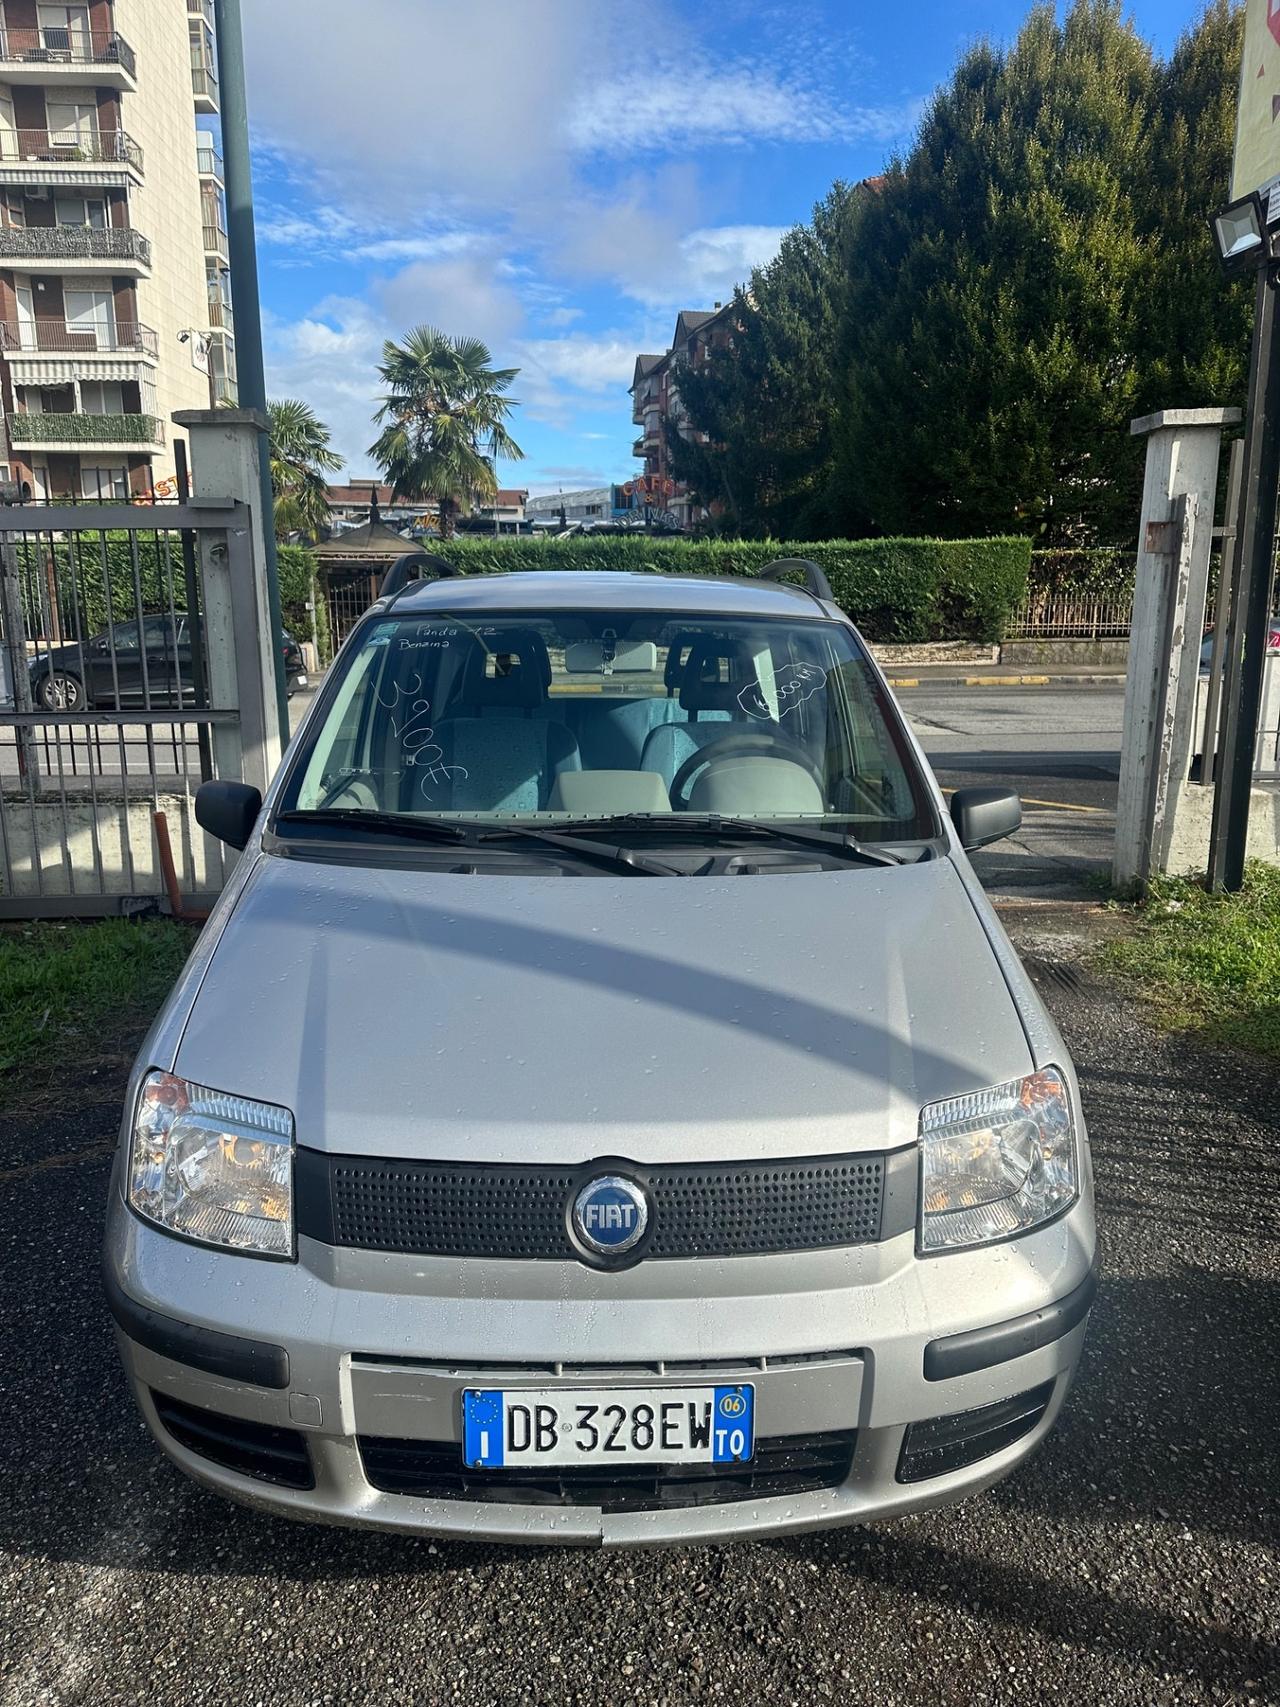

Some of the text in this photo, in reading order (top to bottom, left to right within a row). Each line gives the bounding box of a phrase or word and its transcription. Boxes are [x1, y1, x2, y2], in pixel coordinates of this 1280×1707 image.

[615, 506, 680, 530] DRINKS
[415, 623, 458, 637] Panda
[586, 1204, 635, 1228] FIAT
[723, 1397, 740, 1413] 06
[507, 1401, 713, 1452] DB 328EW
[480, 1431, 489, 1458] I
[715, 1429, 745, 1456] TO
